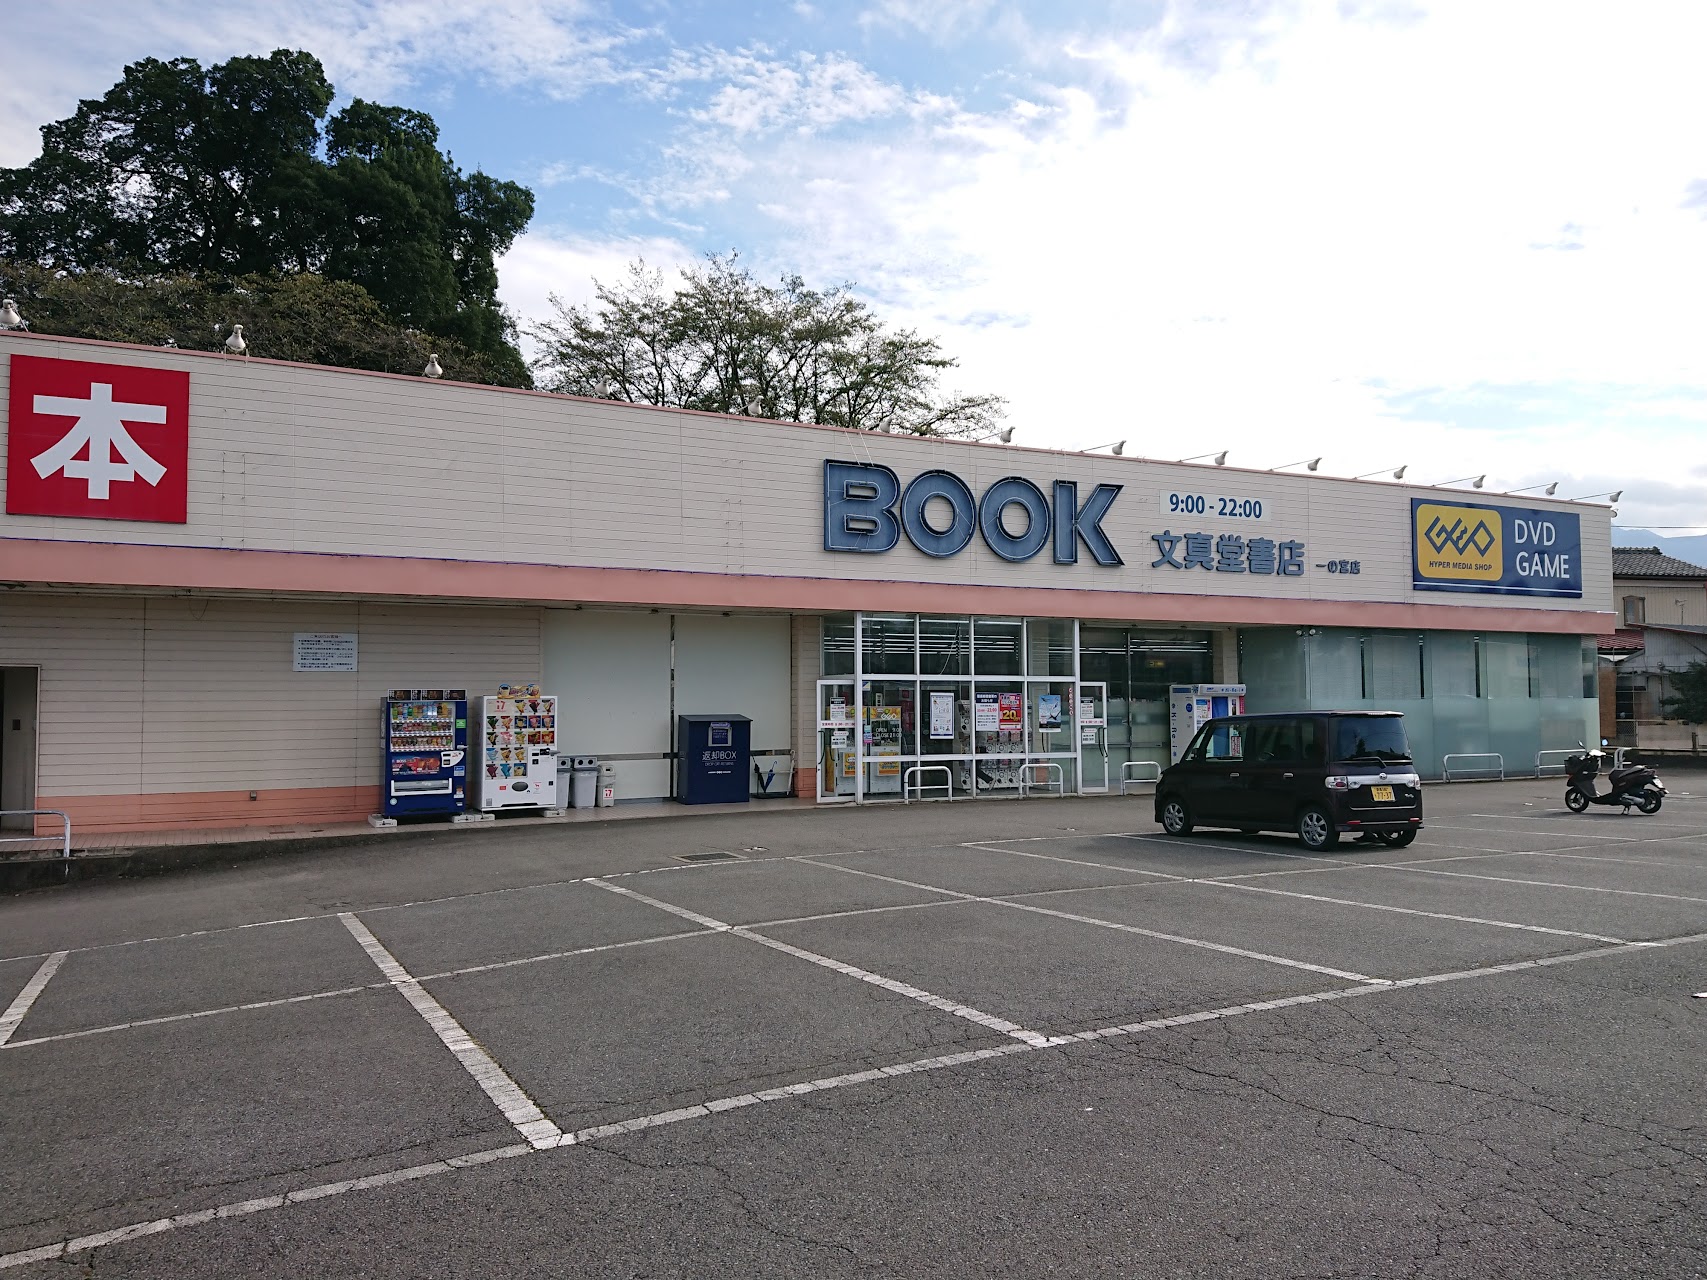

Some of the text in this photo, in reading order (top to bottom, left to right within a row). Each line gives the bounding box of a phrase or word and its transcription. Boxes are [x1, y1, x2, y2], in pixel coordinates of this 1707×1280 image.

[30, 382, 168, 500] 本
[823, 458, 1125, 566] BOOK
[1169, 493, 1205, 515] 9:00
[1218, 497, 1262, 519] 22:00
[1424, 515, 1496, 558] GEO
[1514, 519, 1556, 546] DVD
[1151, 529, 1361, 576] 文真堂書店 一の宮店
[1429, 560, 1493, 571] HYPER MEDIA SHOP
[1516, 551, 1570, 579] GAME
[1002, 710, 1017, 720] 20
[702, 751, 737, 761] 返却BOX
